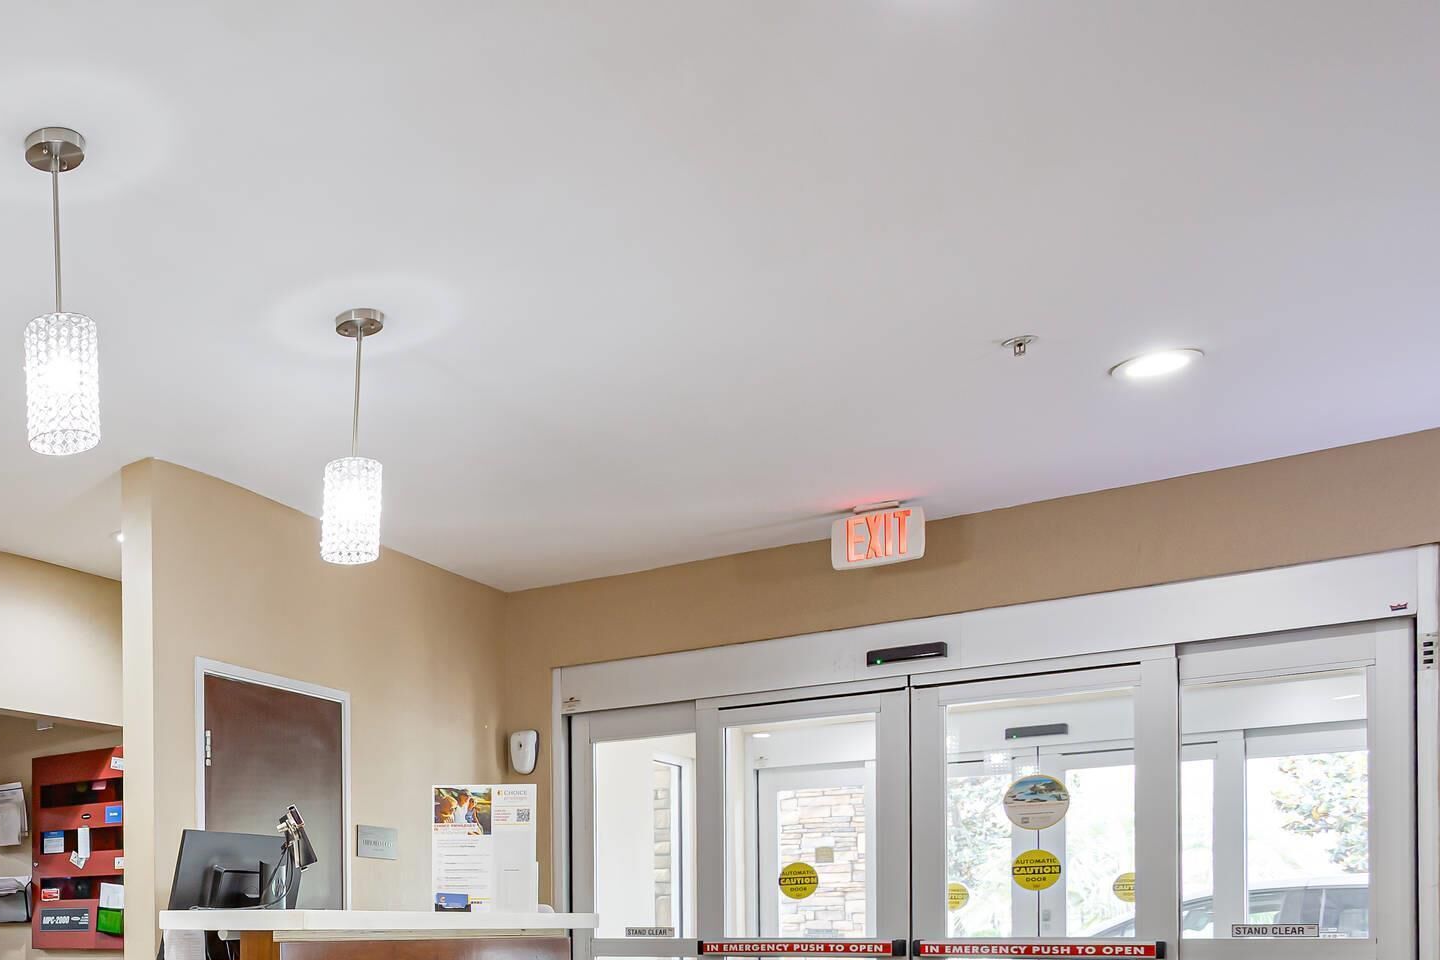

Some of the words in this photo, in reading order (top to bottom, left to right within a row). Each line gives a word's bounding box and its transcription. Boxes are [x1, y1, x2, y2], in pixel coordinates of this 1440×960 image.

[845, 509, 912, 562] EXIT
[1013, 866, 1060, 875] CAUTION
[780, 877, 817, 885] CAUTION
[627, 928, 647, 936] STAND
[648, 928, 668, 936] CLEAR
[1234, 926, 1268, 935] STAND
[1271, 926, 1305, 935] CLEAR
[706, 944, 719, 952] IN
[723, 943, 789, 952] EMERGENCY
[793, 943, 825, 952] PUSH
[828, 943, 845, 952] TO
[849, 944, 883, 953] OPEN
[924, 945, 939, 953] IN
[945, 945, 1027, 954] EMERGENCY
[1032, 946, 1071, 955] PUSH
[1076, 946, 1096, 955] TO
[1102, 946, 1145, 955] OPEN
